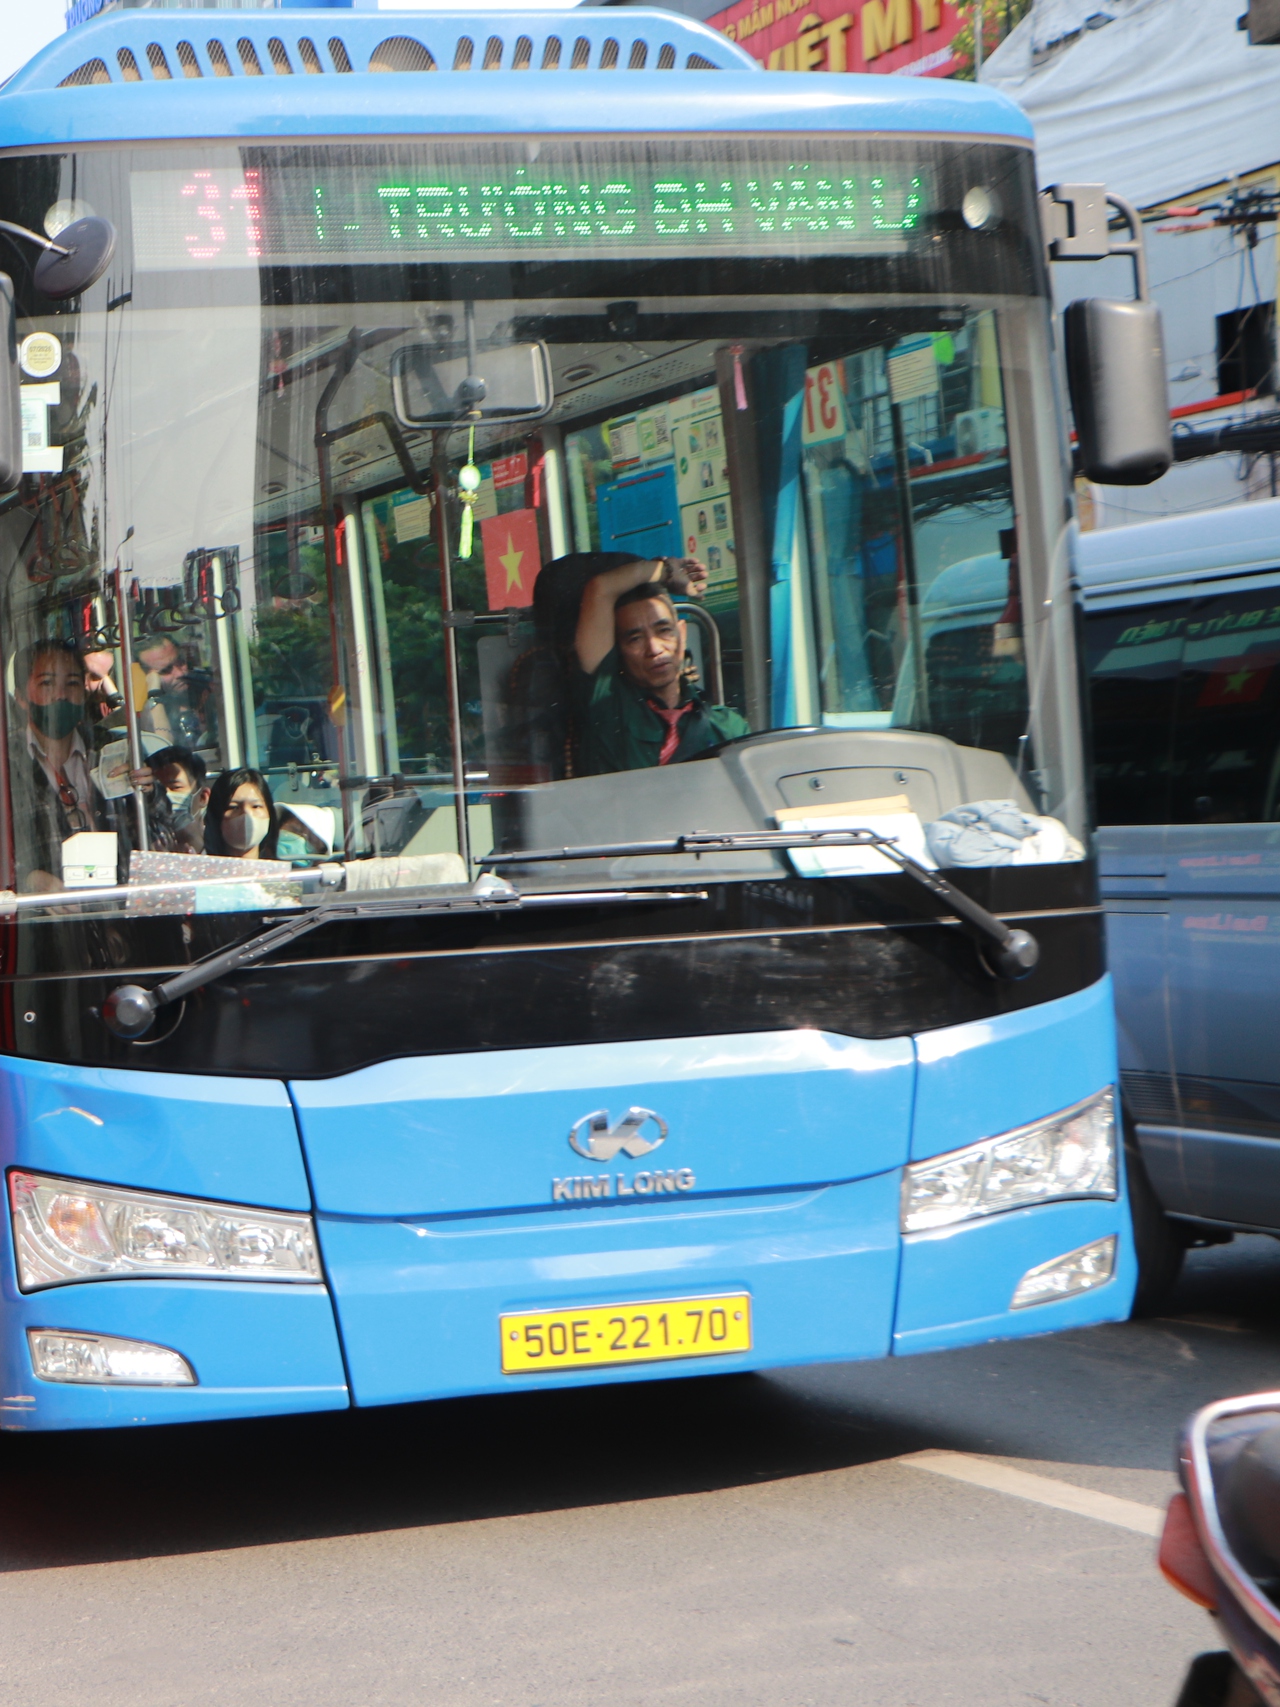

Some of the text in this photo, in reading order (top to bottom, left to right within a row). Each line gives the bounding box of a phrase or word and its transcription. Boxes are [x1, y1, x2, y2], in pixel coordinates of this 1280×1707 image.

[181, 172, 261, 256] 31
[552, 1168, 697, 1201] KIM LONG
